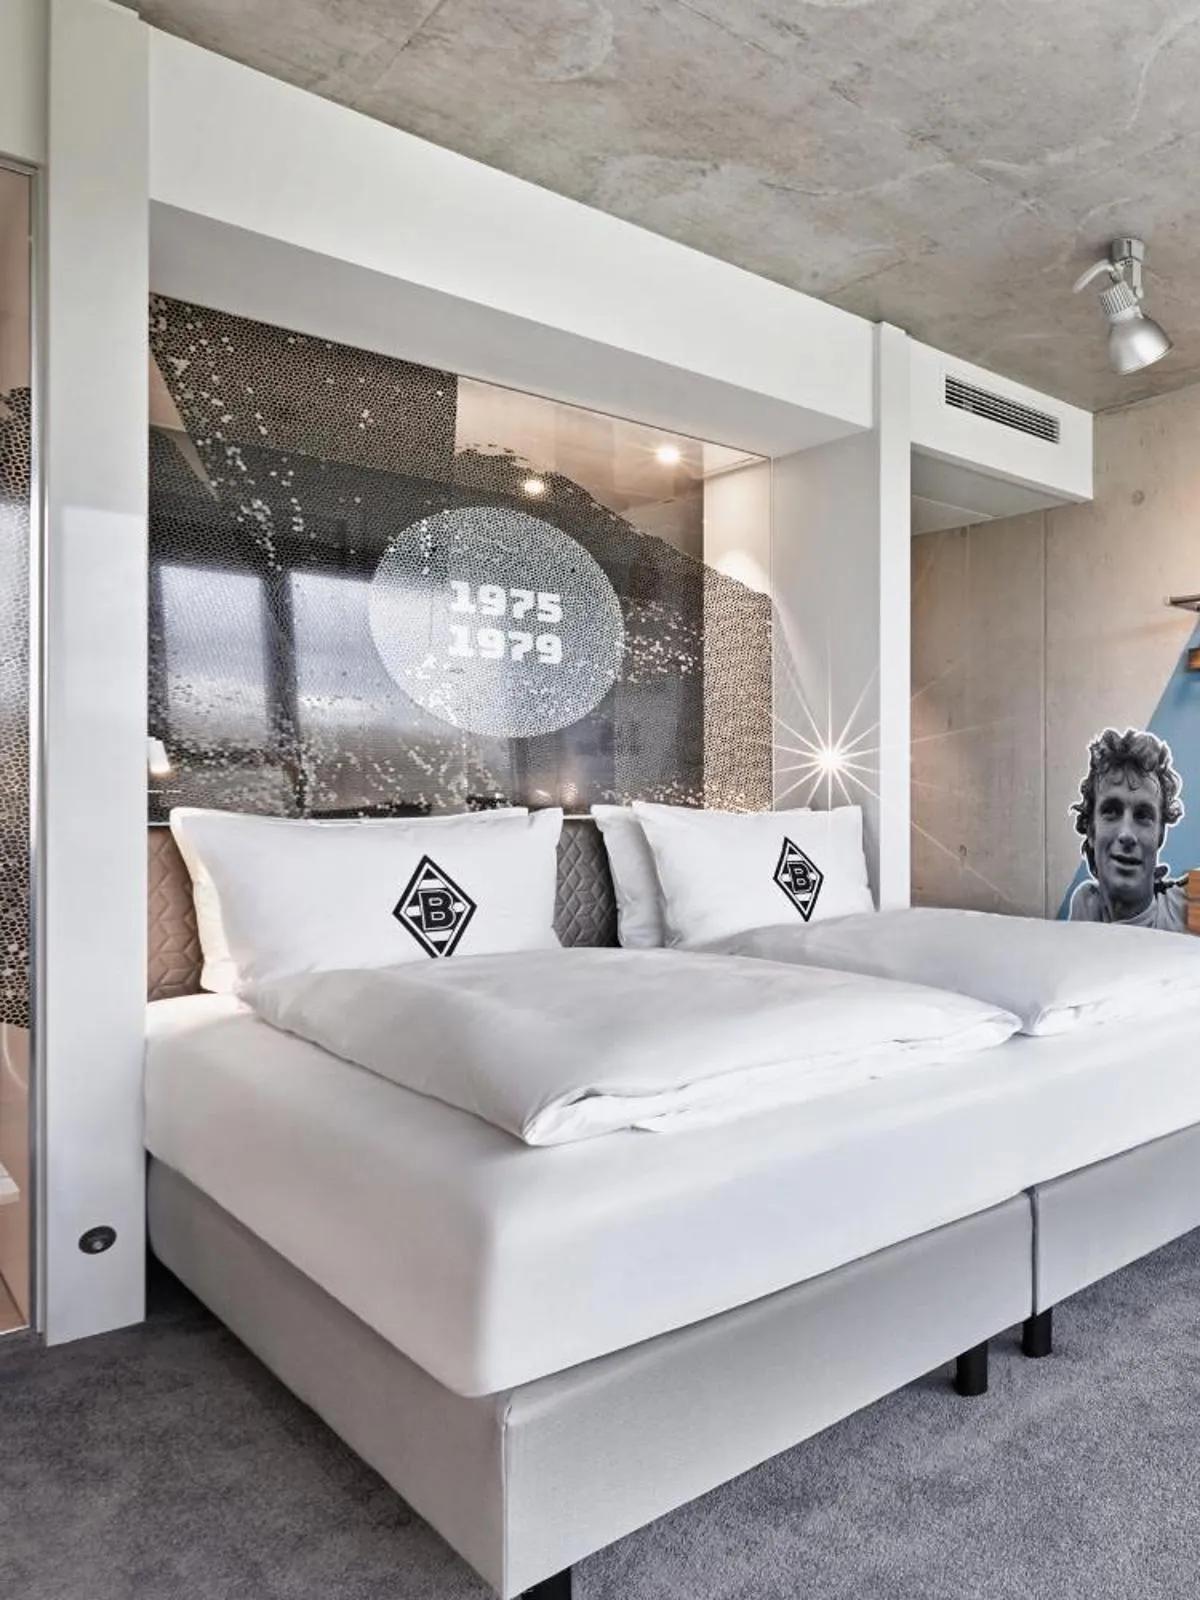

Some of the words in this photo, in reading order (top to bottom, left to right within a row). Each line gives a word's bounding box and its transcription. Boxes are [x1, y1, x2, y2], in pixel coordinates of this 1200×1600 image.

[449, 579, 562, 623] 1975
[447, 624, 562, 664] 1979
[787, 860, 814, 895] B
[417, 888, 456, 931] B
